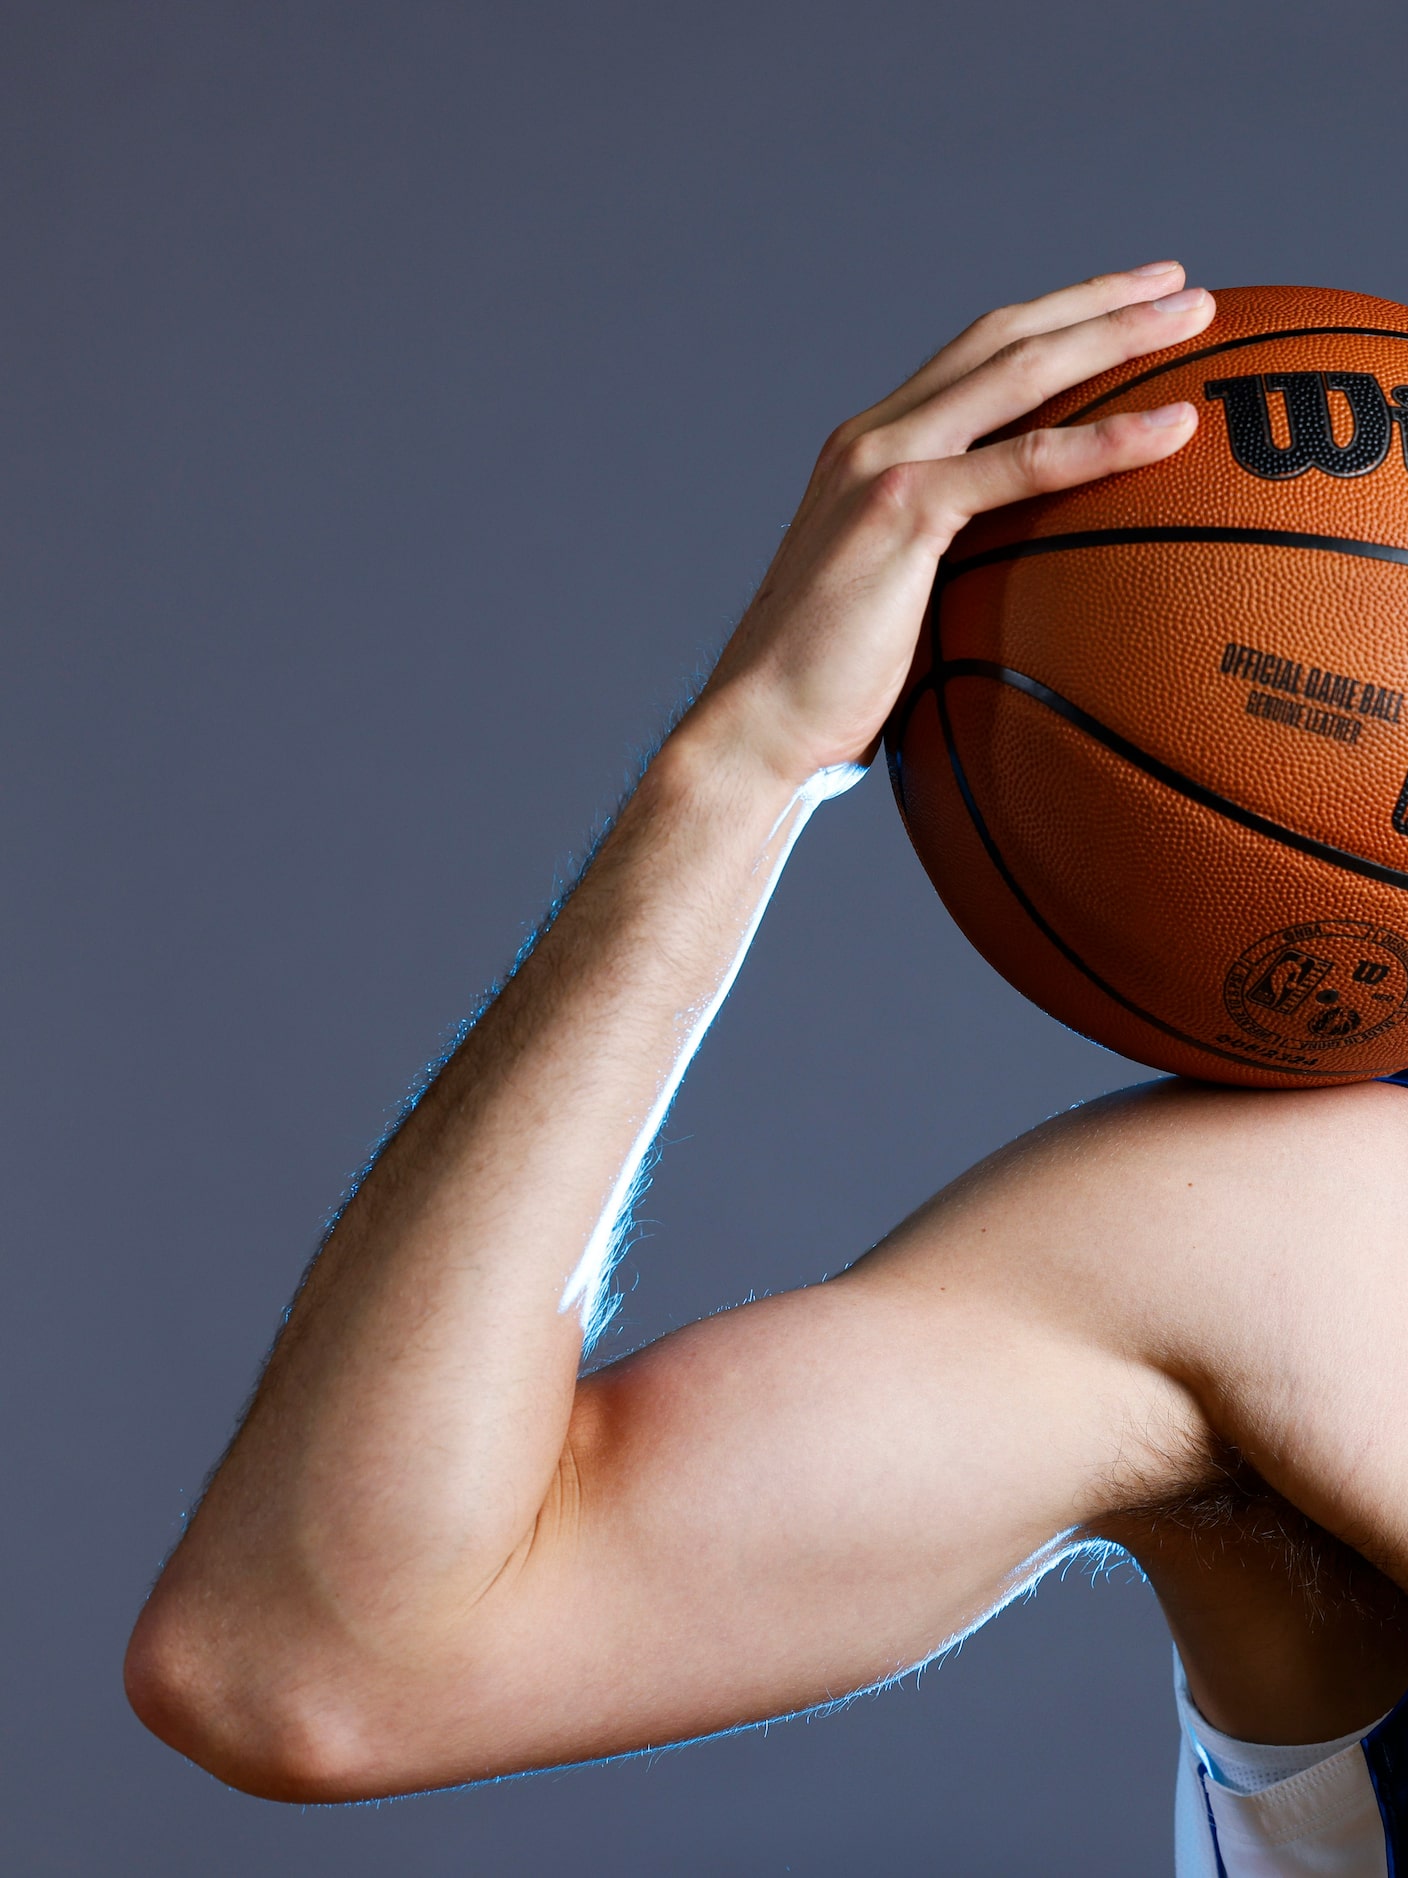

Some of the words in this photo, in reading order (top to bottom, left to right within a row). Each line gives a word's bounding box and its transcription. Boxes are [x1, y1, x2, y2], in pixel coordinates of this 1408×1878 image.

[1220, 642, 1303, 694] OFFICIAL
[1305, 668, 1361, 710] GAME
[1359, 684, 1405, 724] BALL
[1246, 691, 1303, 727] GENUINE
[1304, 709, 1362, 745] LEATHER
